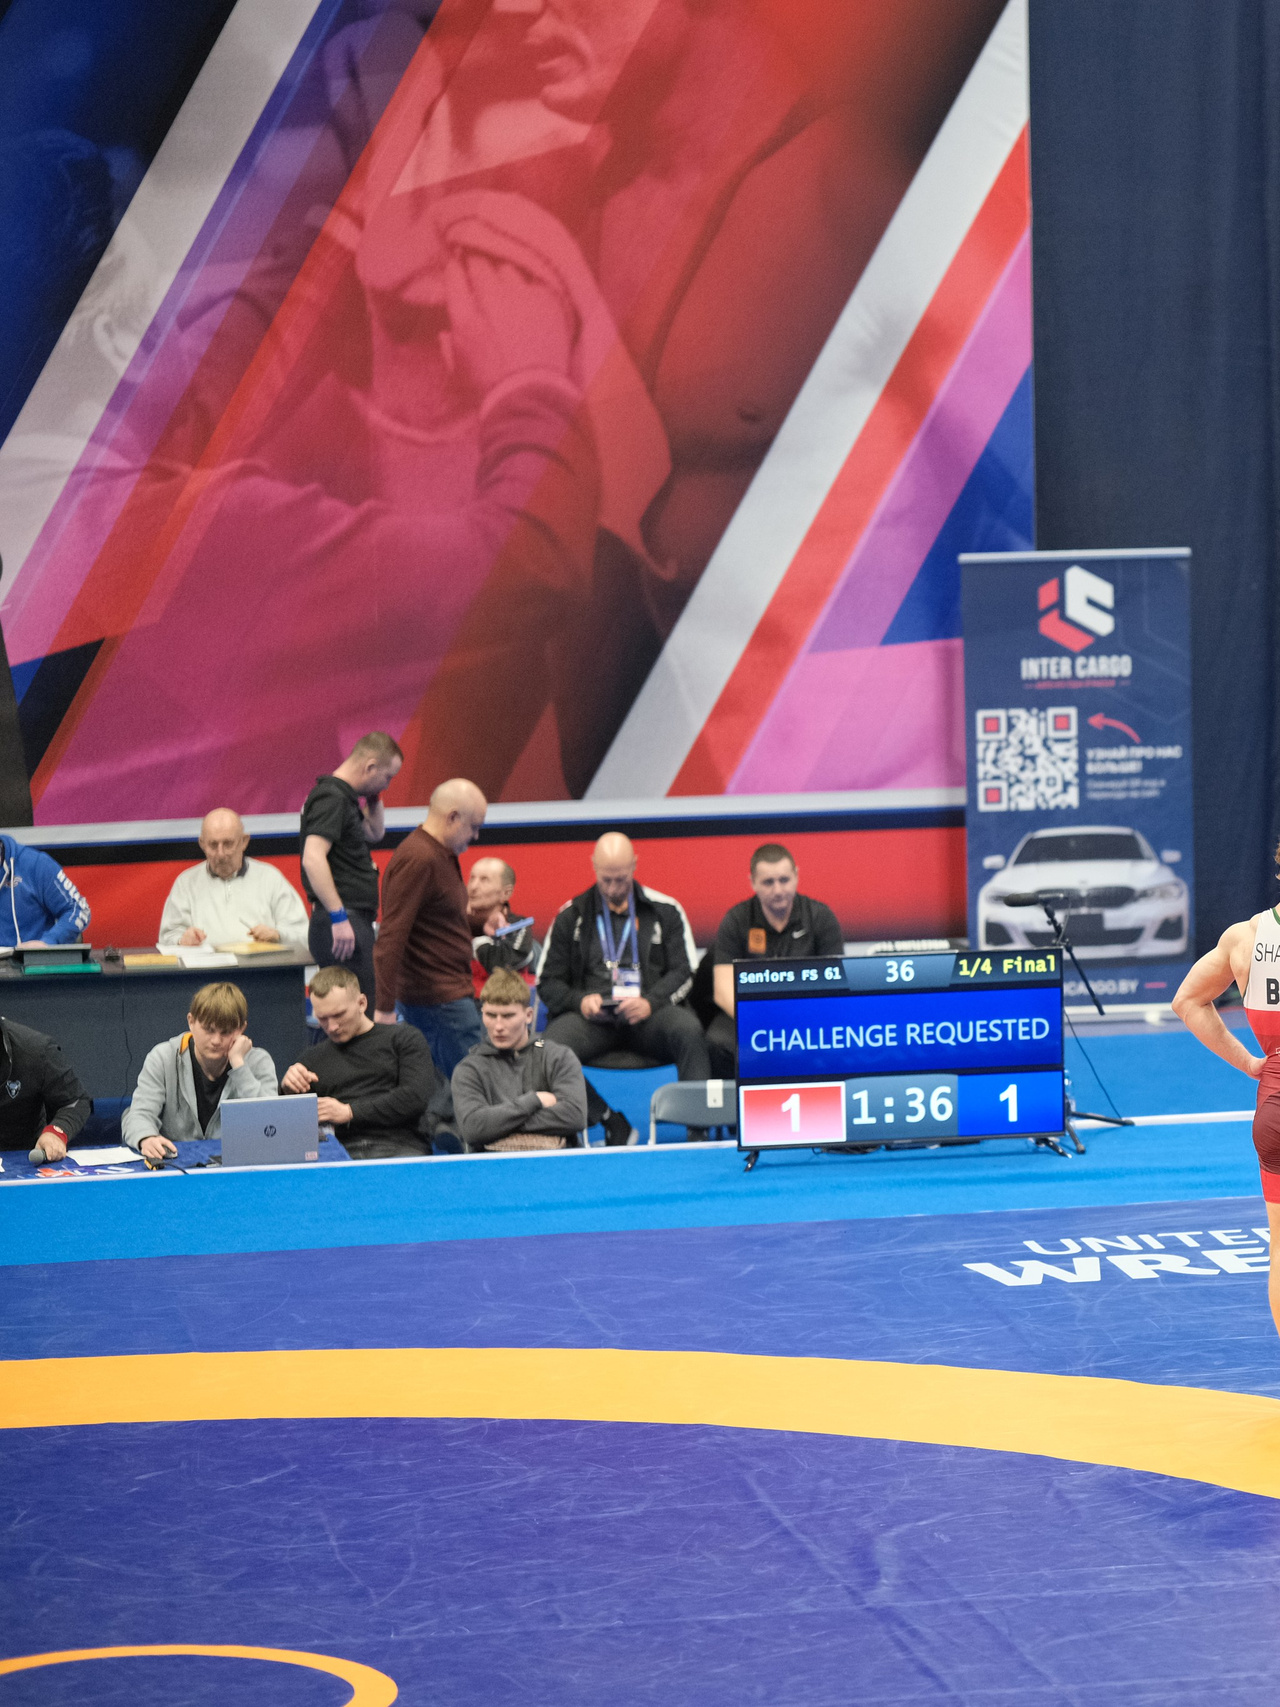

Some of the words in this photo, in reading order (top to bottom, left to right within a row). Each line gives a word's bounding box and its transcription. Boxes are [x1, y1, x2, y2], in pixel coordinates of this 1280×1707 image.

[1021, 656, 1072, 680] INTER
[1075, 654, 1132, 679] CARGO
[740, 969, 795, 984] Seniors
[801, 968, 819, 981] FS
[824, 966, 842, 980] 61
[885, 960, 915, 983] 36
[959, 957, 992, 978] 1/4
[1003, 955, 1056, 974] Final
[751, 1024, 898, 1052] CHALLENGE
[906, 1017, 1050, 1046] REQUESTED
[781, 1093, 801, 1133] 1
[852, 1086, 953, 1125] 1:36
[999, 1084, 1018, 1122] 1
[1023, 1227, 1271, 1255] UNITE
